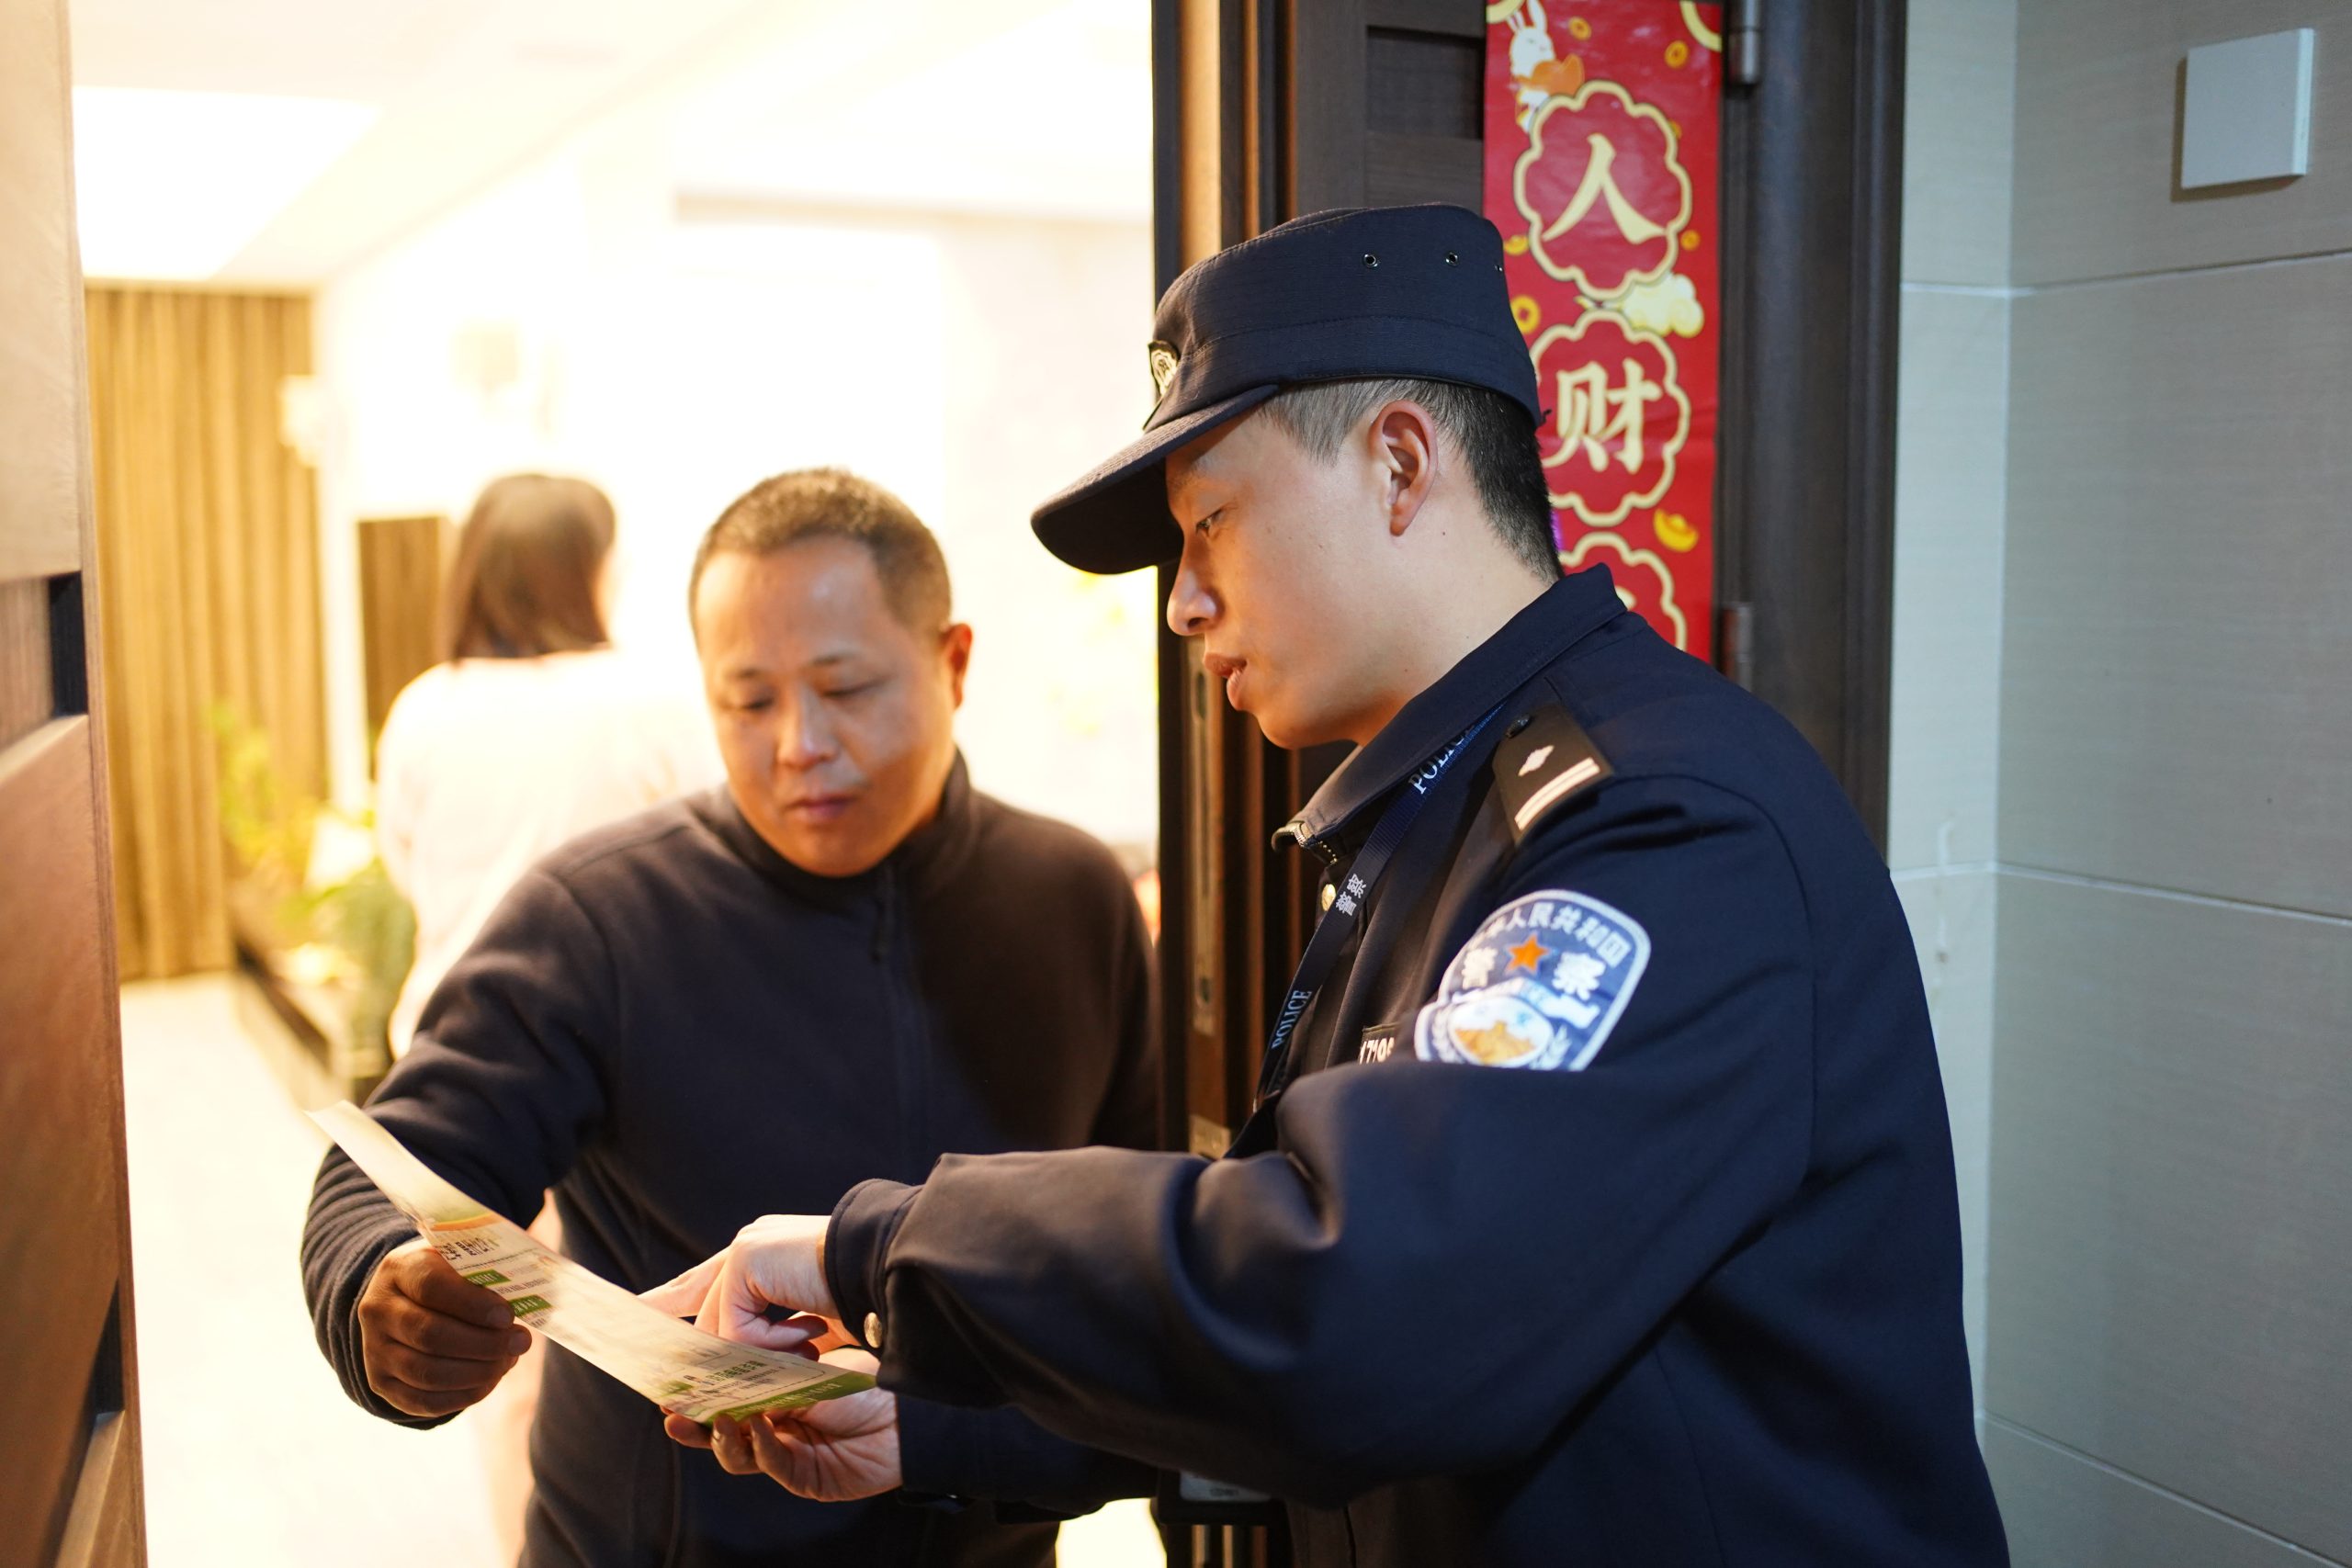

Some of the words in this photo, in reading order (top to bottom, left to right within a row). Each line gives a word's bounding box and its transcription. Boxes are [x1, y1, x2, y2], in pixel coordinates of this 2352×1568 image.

[1408, 725, 1475, 795] POLIC
[1335, 873, 1367, 917] 警察
[1271, 989, 1312, 1049] POLICE
